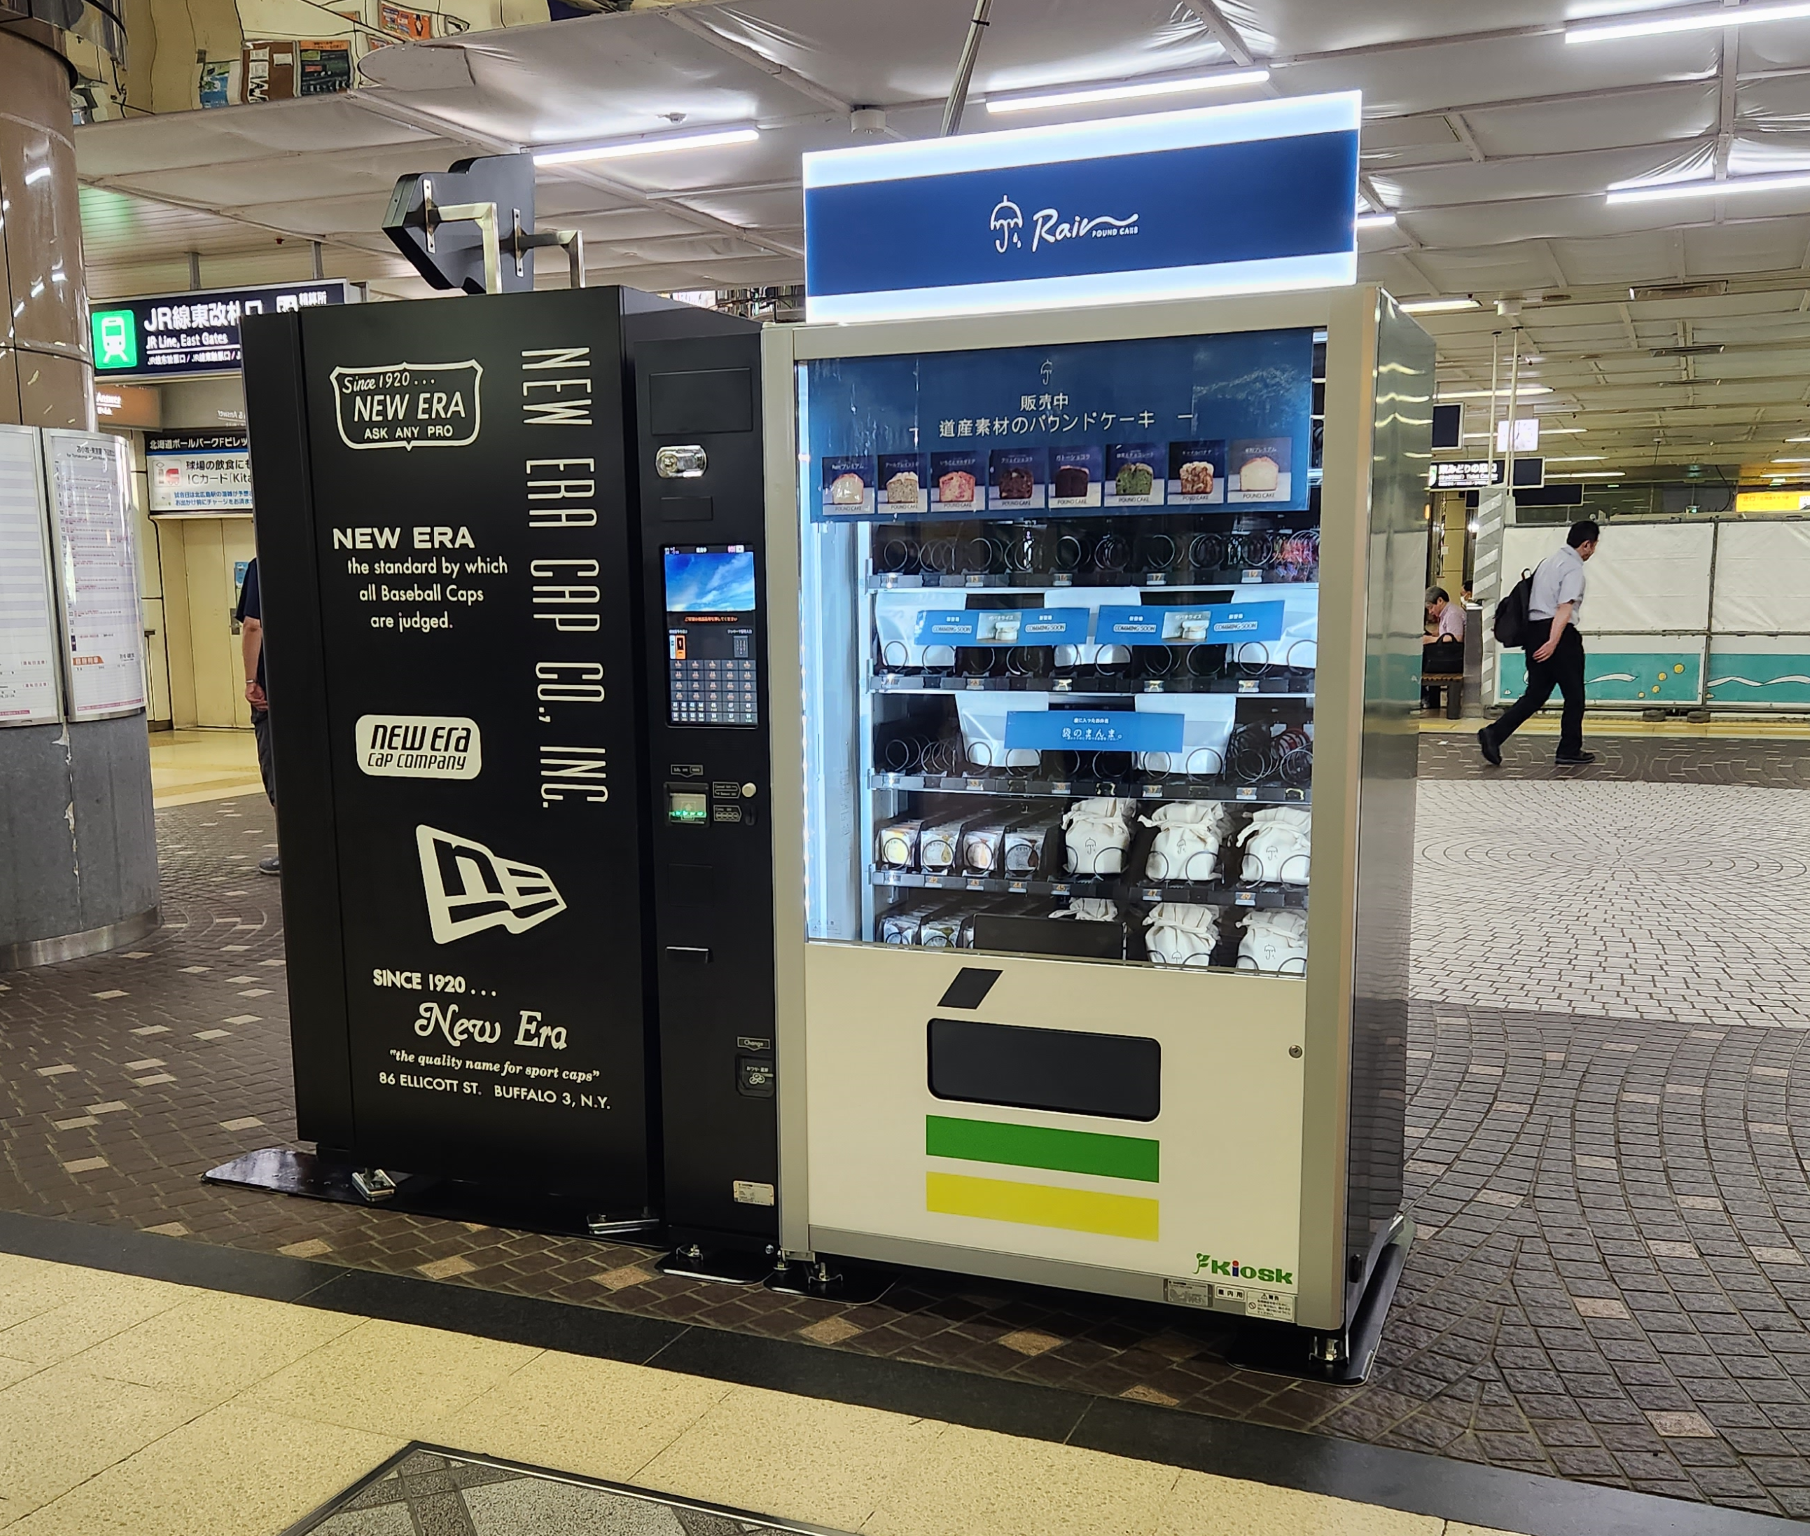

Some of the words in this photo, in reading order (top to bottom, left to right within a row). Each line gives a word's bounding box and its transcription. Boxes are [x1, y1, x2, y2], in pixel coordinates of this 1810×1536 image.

[1031, 207, 1139, 253] Rain
[146, 336, 157, 350] JR
[181, 332, 200, 347] East
[202, 331, 228, 346] Gates
[342, 375, 376, 394] Since
[521, 347, 593, 425] NEW
[353, 394, 410, 423] NEW
[416, 391, 466, 420] ERA
[1020, 392, 1069, 411] 販売中
[364, 426, 388, 440] ASK
[395, 425, 419, 439] ANY
[428, 424, 453, 438] PRO
[938, 410, 1155, 438] 道産素材のパウンドケーキ
[526, 458, 597, 527] ERA
[332, 527, 401, 550] NEW
[413, 526, 475, 549] ERA
[347, 557, 370, 575] the
[373, 556, 437, 575] standard
[441, 555, 460, 579] by
[464, 555, 508, 574] which
[359, 583, 377, 602] all
[381, 583, 441, 602] Baseball
[446, 584, 484, 606] Caps
[530, 558, 600, 631] CAP
[370, 616, 394, 629] are
[398, 611, 453, 633] judged.
[956, 625, 972, 633] SOON
[1050, 623, 1066, 632] SOON
[1240, 622, 1257, 630] SOON
[539, 746, 608, 808] INC.
[373, 968, 422, 990] SINCE
[414, 1002, 501, 1047] New
[514, 1010, 568, 1050] Era
[418, 1053, 462, 1070] quality
[465, 1060, 500, 1073] name
[525, 1064, 559, 1079] sport
[379, 1072, 396, 1085] 86
[400, 1073, 459, 1093] ELLICOTT
[462, 1081, 482, 1096] ST.
[494, 1085, 557, 1104] BUFFALO
[561, 1092, 576, 1108] 3,
[581, 1094, 611, 1110] N.Y.
[1211, 1259, 1293, 1285] Kiosk
